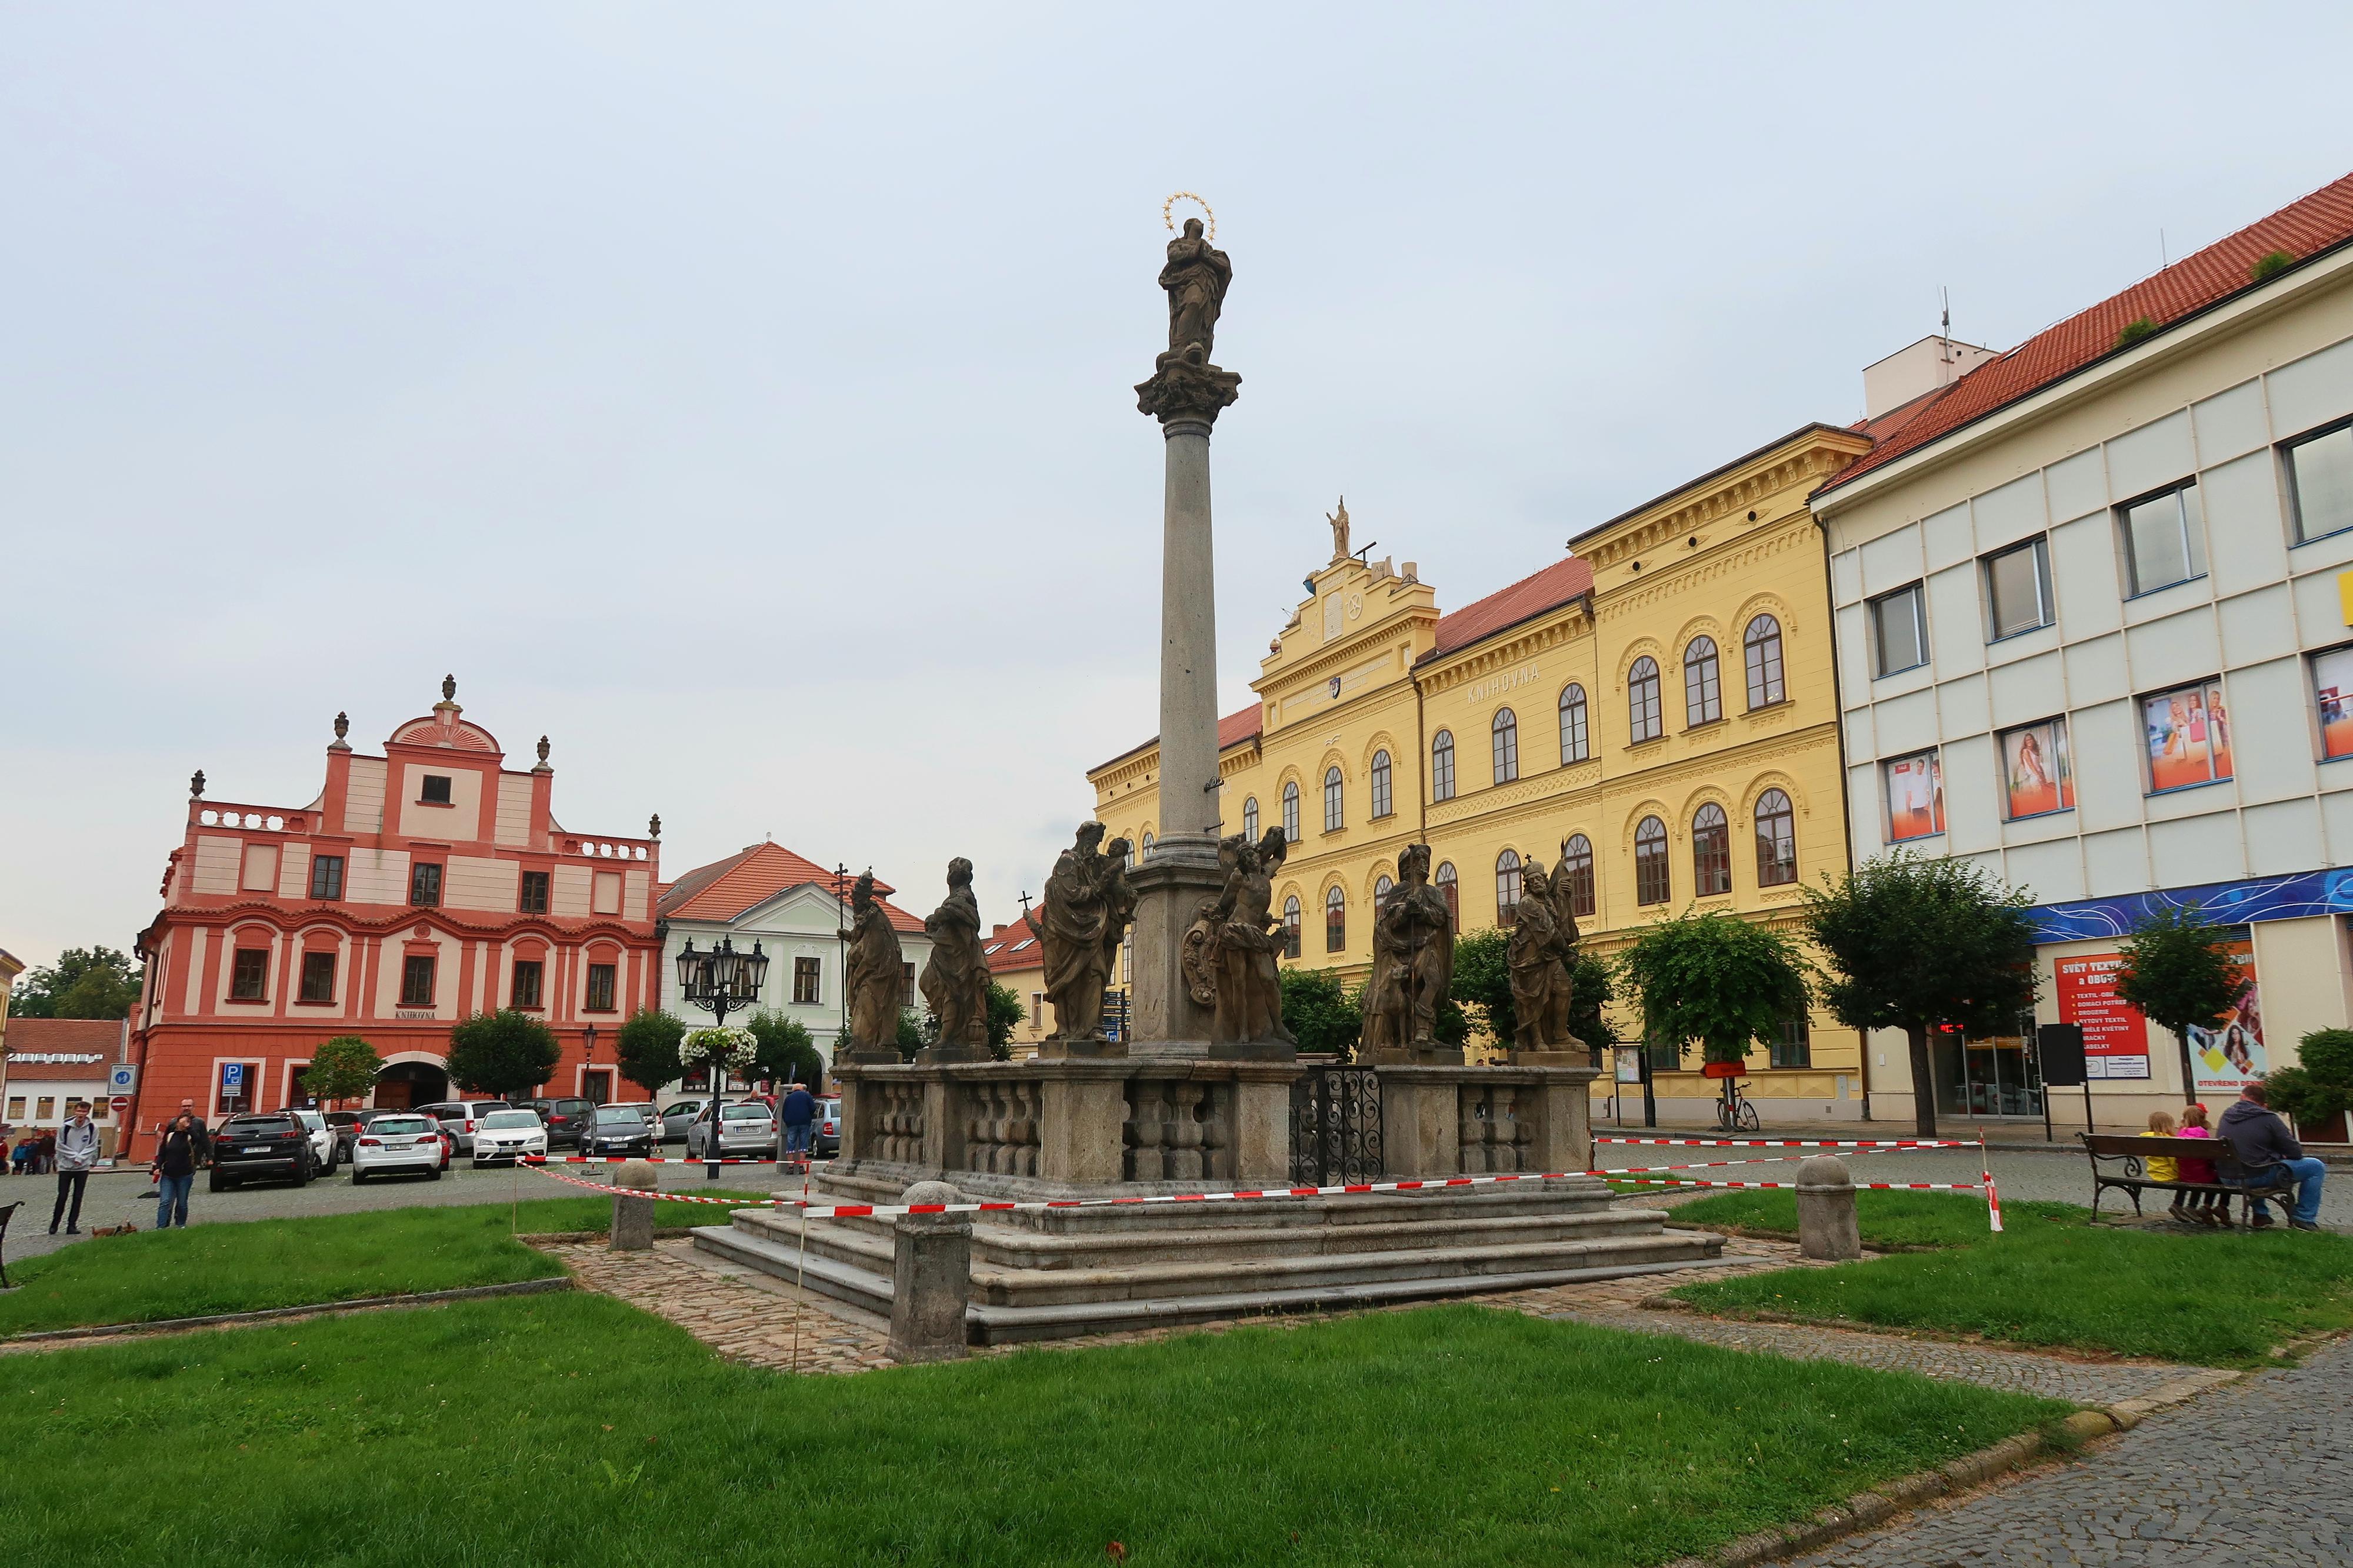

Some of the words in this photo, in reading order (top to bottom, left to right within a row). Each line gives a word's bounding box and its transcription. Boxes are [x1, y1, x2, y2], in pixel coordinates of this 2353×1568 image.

[1468, 663, 1540, 705] KNIHOVNA
[2062, 961, 2087, 973] SVĚT
[395, 1011, 435, 1019] KNIHOVNA
[228, 1066, 238, 1079] P
